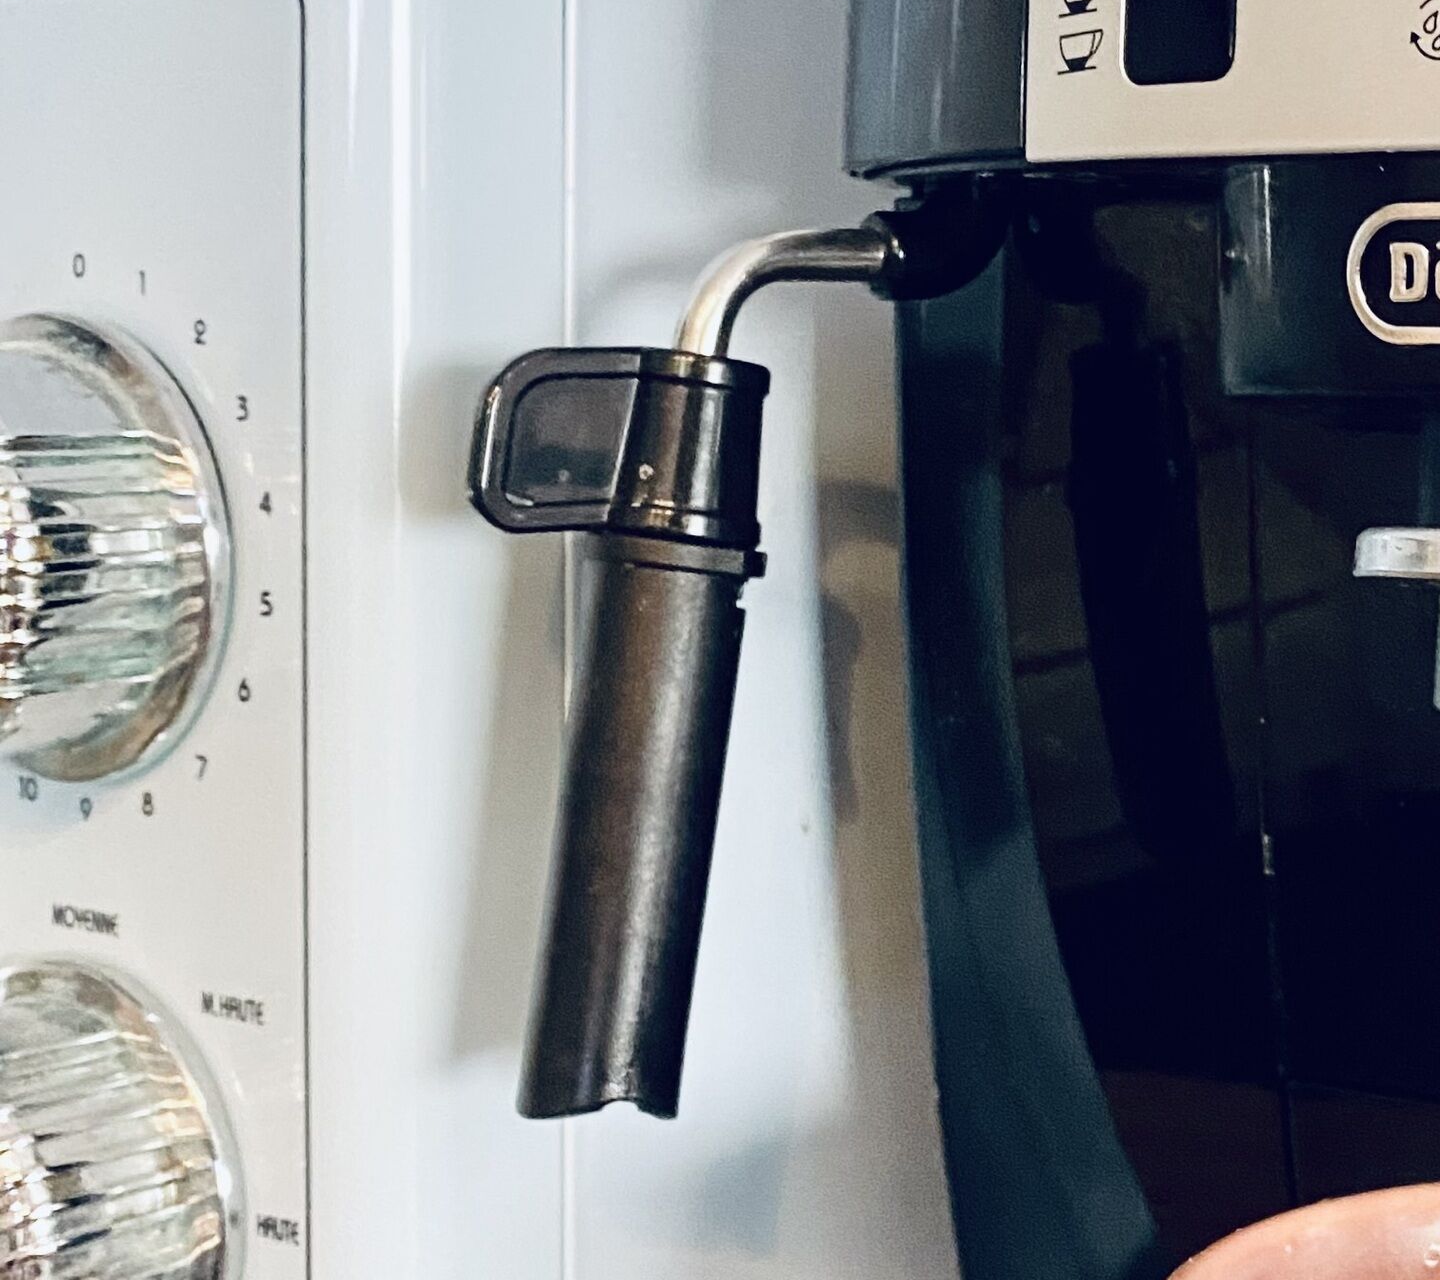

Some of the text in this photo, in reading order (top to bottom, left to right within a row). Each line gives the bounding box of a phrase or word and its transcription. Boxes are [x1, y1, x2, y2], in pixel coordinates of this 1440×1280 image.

[139, 270, 146, 296] 1
[194, 319, 208, 345] 2
[236, 395, 249, 421] 3
[259, 491, 272, 514] 4
[260, 591, 273, 616] 5
[238, 678, 251, 703] 6
[195, 754, 208, 779] 7
[19, 776, 39, 802] 10
[79, 797, 93, 820] 9
[142, 792, 154, 817] 8
